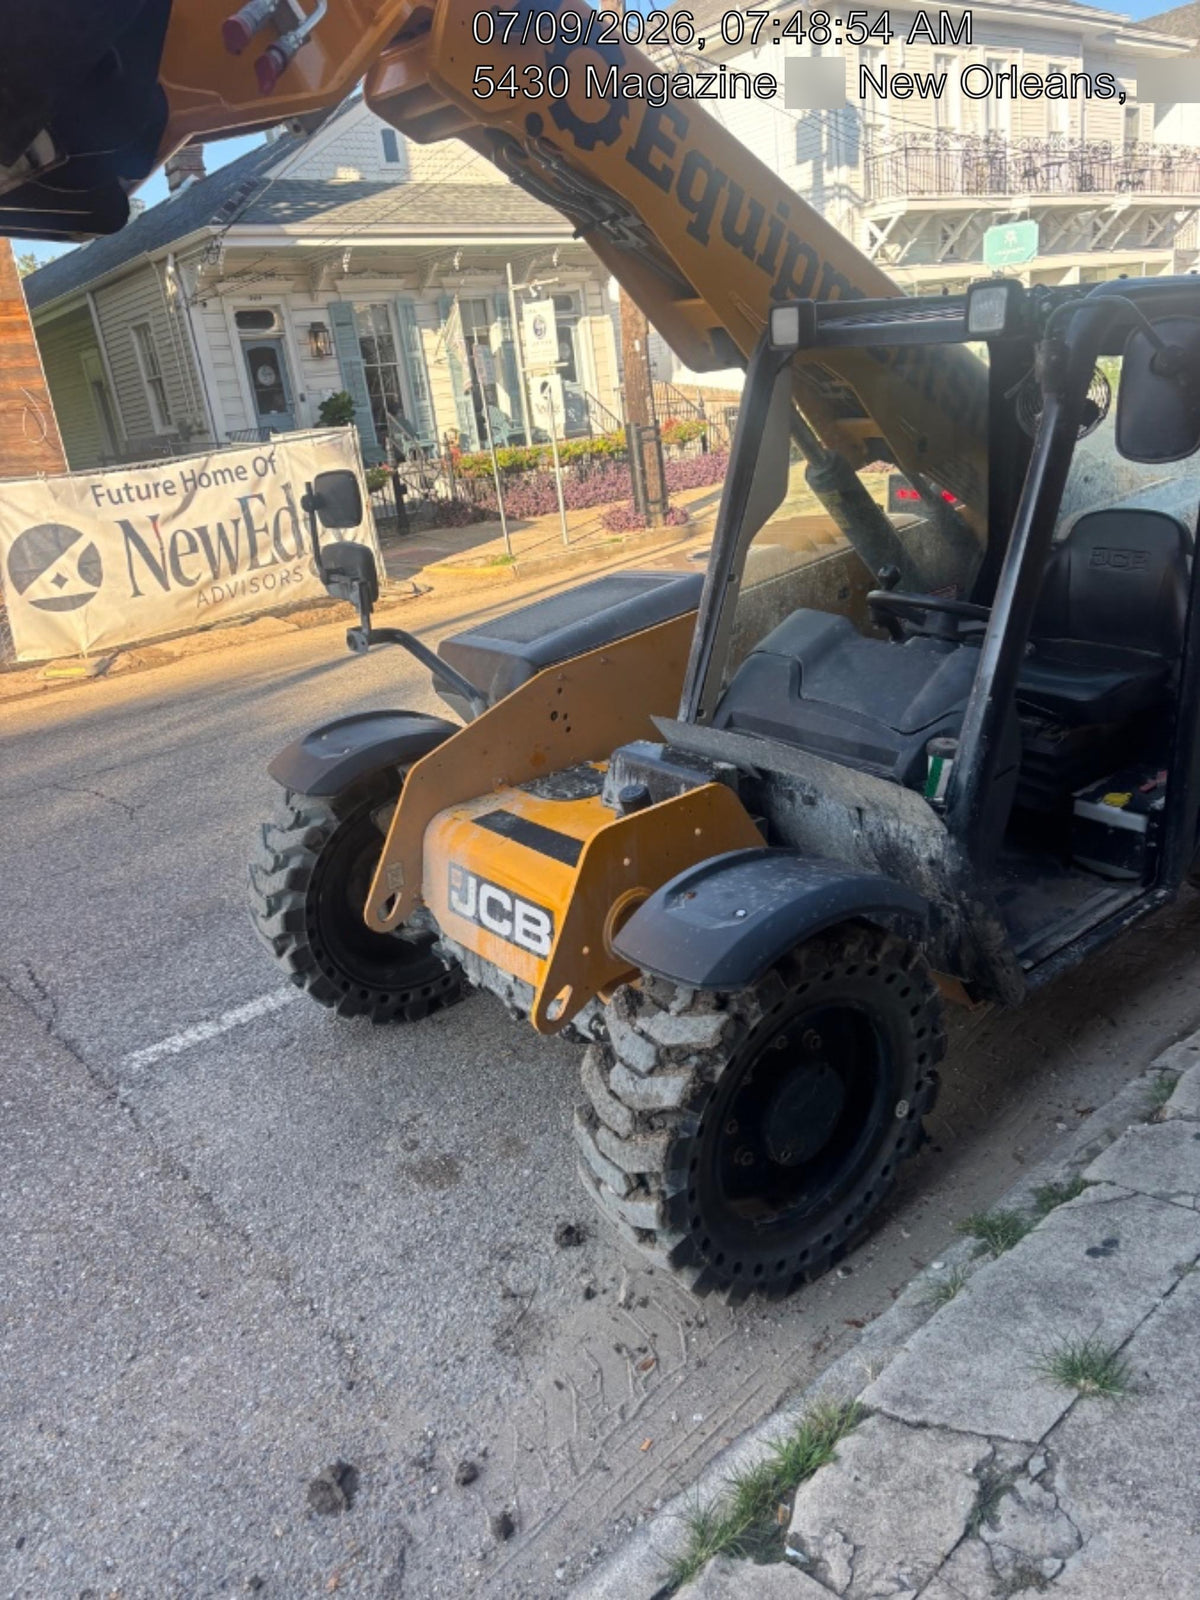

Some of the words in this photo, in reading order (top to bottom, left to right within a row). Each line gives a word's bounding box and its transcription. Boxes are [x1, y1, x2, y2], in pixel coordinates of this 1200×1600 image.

[91, 475, 176, 507] Future
[180, 465, 248, 493] Home
[252, 453, 279, 477] Of
[115, 482, 314, 598] NewEd
[196, 566, 305, 609] ADVISORS
[450, 874, 552, 956] JCB
